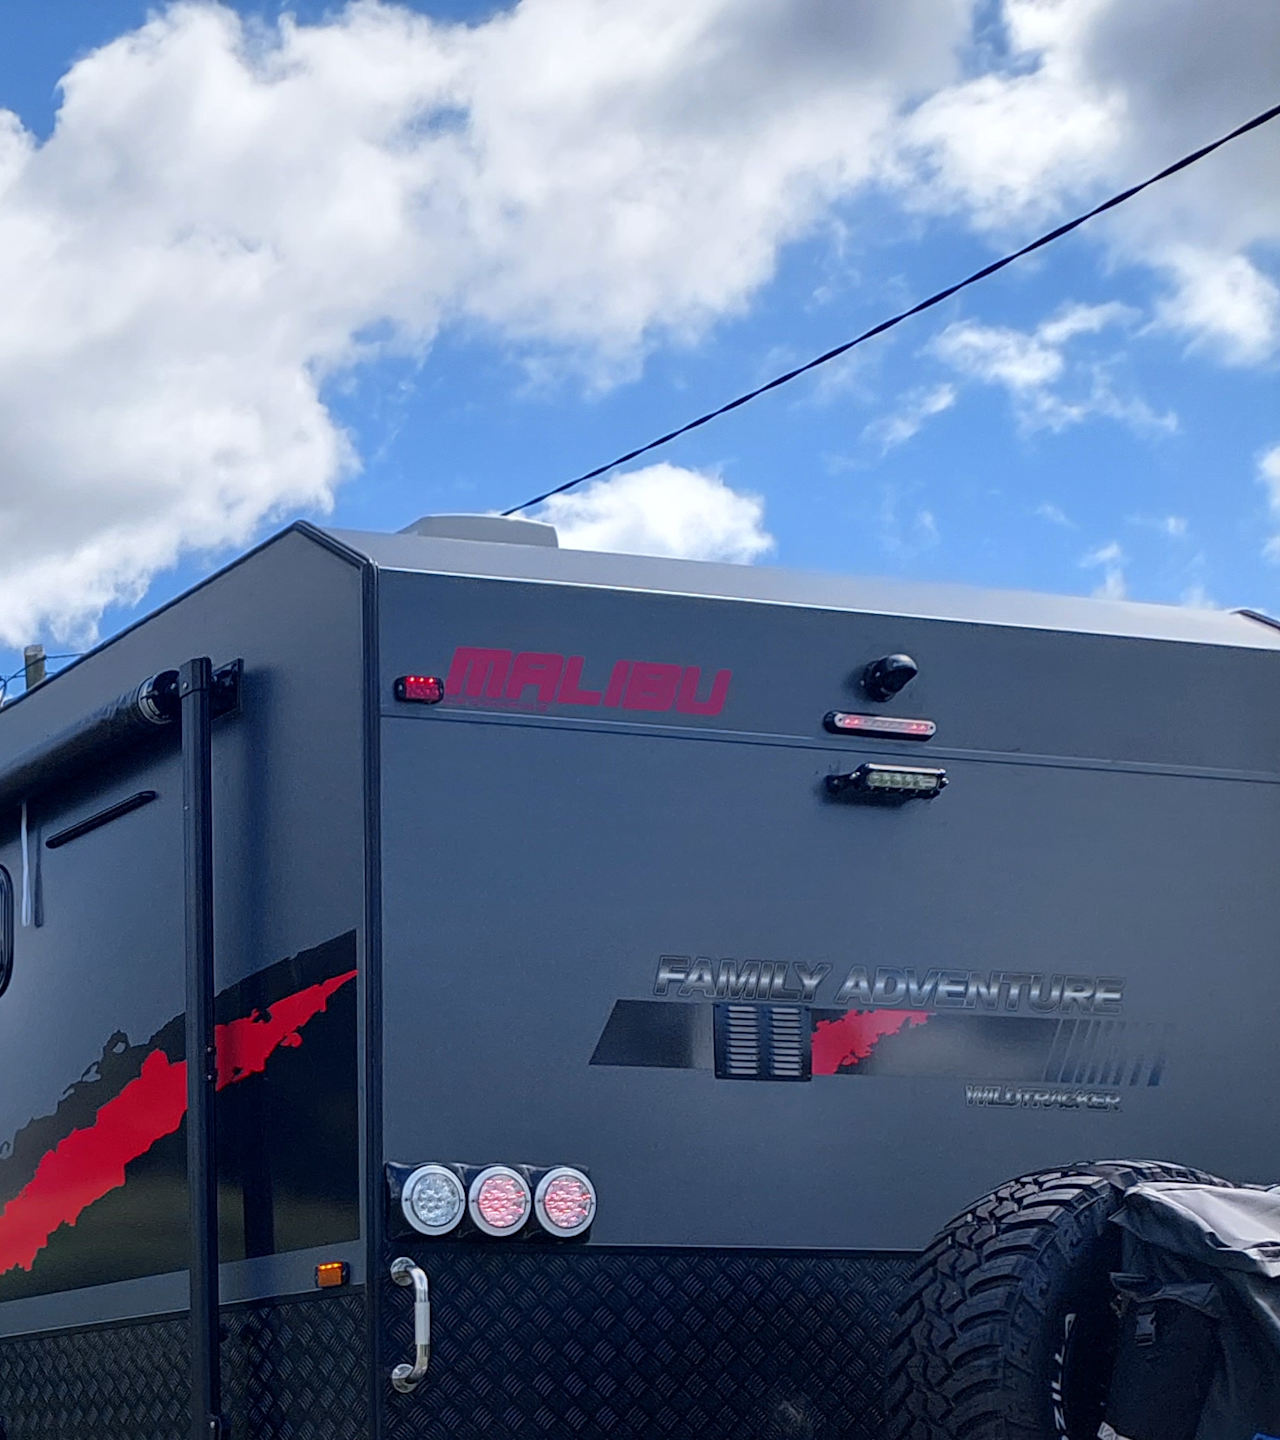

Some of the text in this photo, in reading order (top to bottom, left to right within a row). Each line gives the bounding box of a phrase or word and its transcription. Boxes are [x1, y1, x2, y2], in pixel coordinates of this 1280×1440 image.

[445, 647, 732, 717] MALIBU
[653, 954, 1126, 1015] FAMILY ADVENTURE
